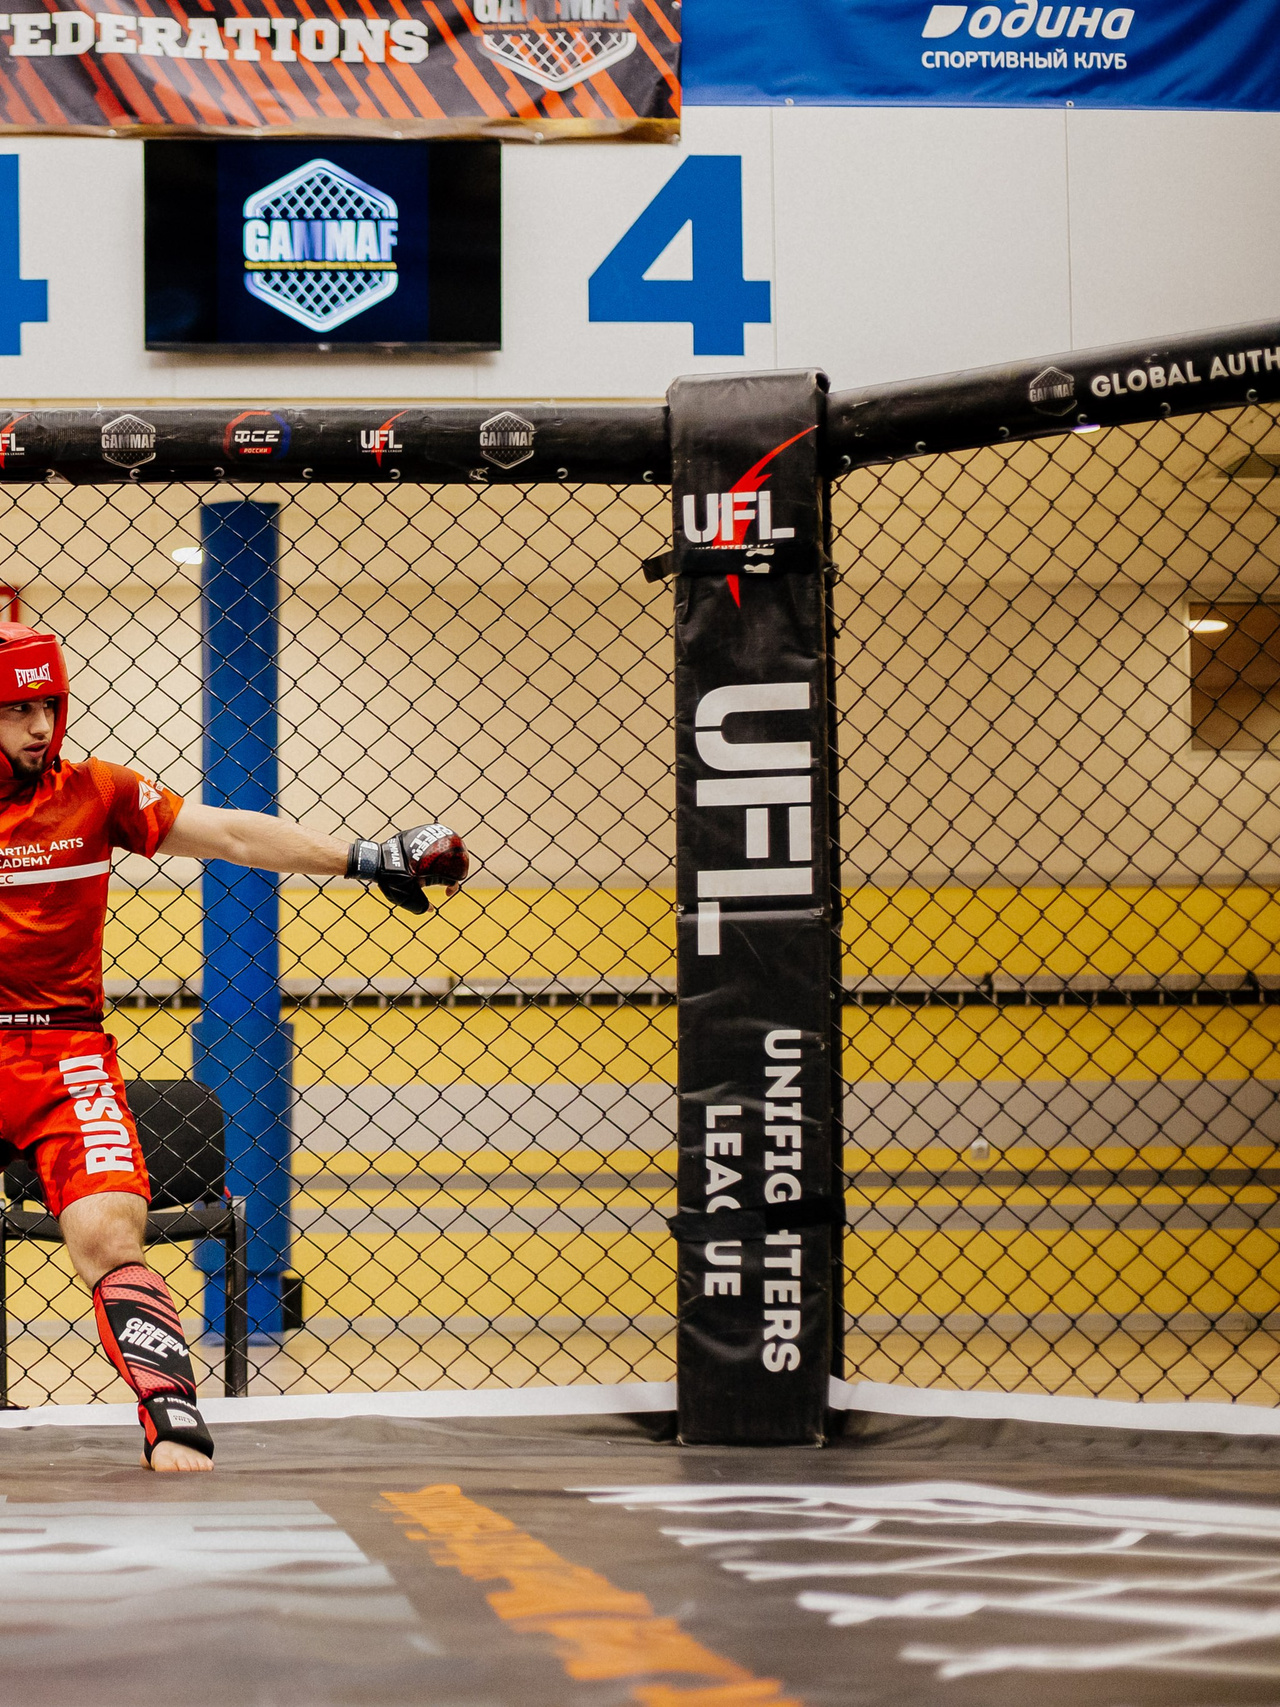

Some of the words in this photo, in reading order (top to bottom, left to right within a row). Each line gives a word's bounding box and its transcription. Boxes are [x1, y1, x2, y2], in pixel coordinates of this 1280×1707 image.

[922, 49, 1067, 69] СПОРТИВНЫЙ
[1075, 53, 1127, 70] КЛУБ
[243, 220, 398, 262] GAMMAF
[588, 155, 771, 356] 4
[1091, 361, 1201, 398] GLOBAL
[101, 434, 156, 449] GAMMAF
[234, 430, 280, 443] ФСЕ
[360, 430, 403, 449] UFL
[480, 431, 535, 447] GAMMAF
[682, 490, 795, 543] UFL
[14, 662, 54, 688] EVERLAST
[695, 682, 813, 956] UFL
[49, 837, 84, 852] ARTS
[118, 1327, 169, 1358] HILL
[126, 1317, 189, 1357] GREEN
